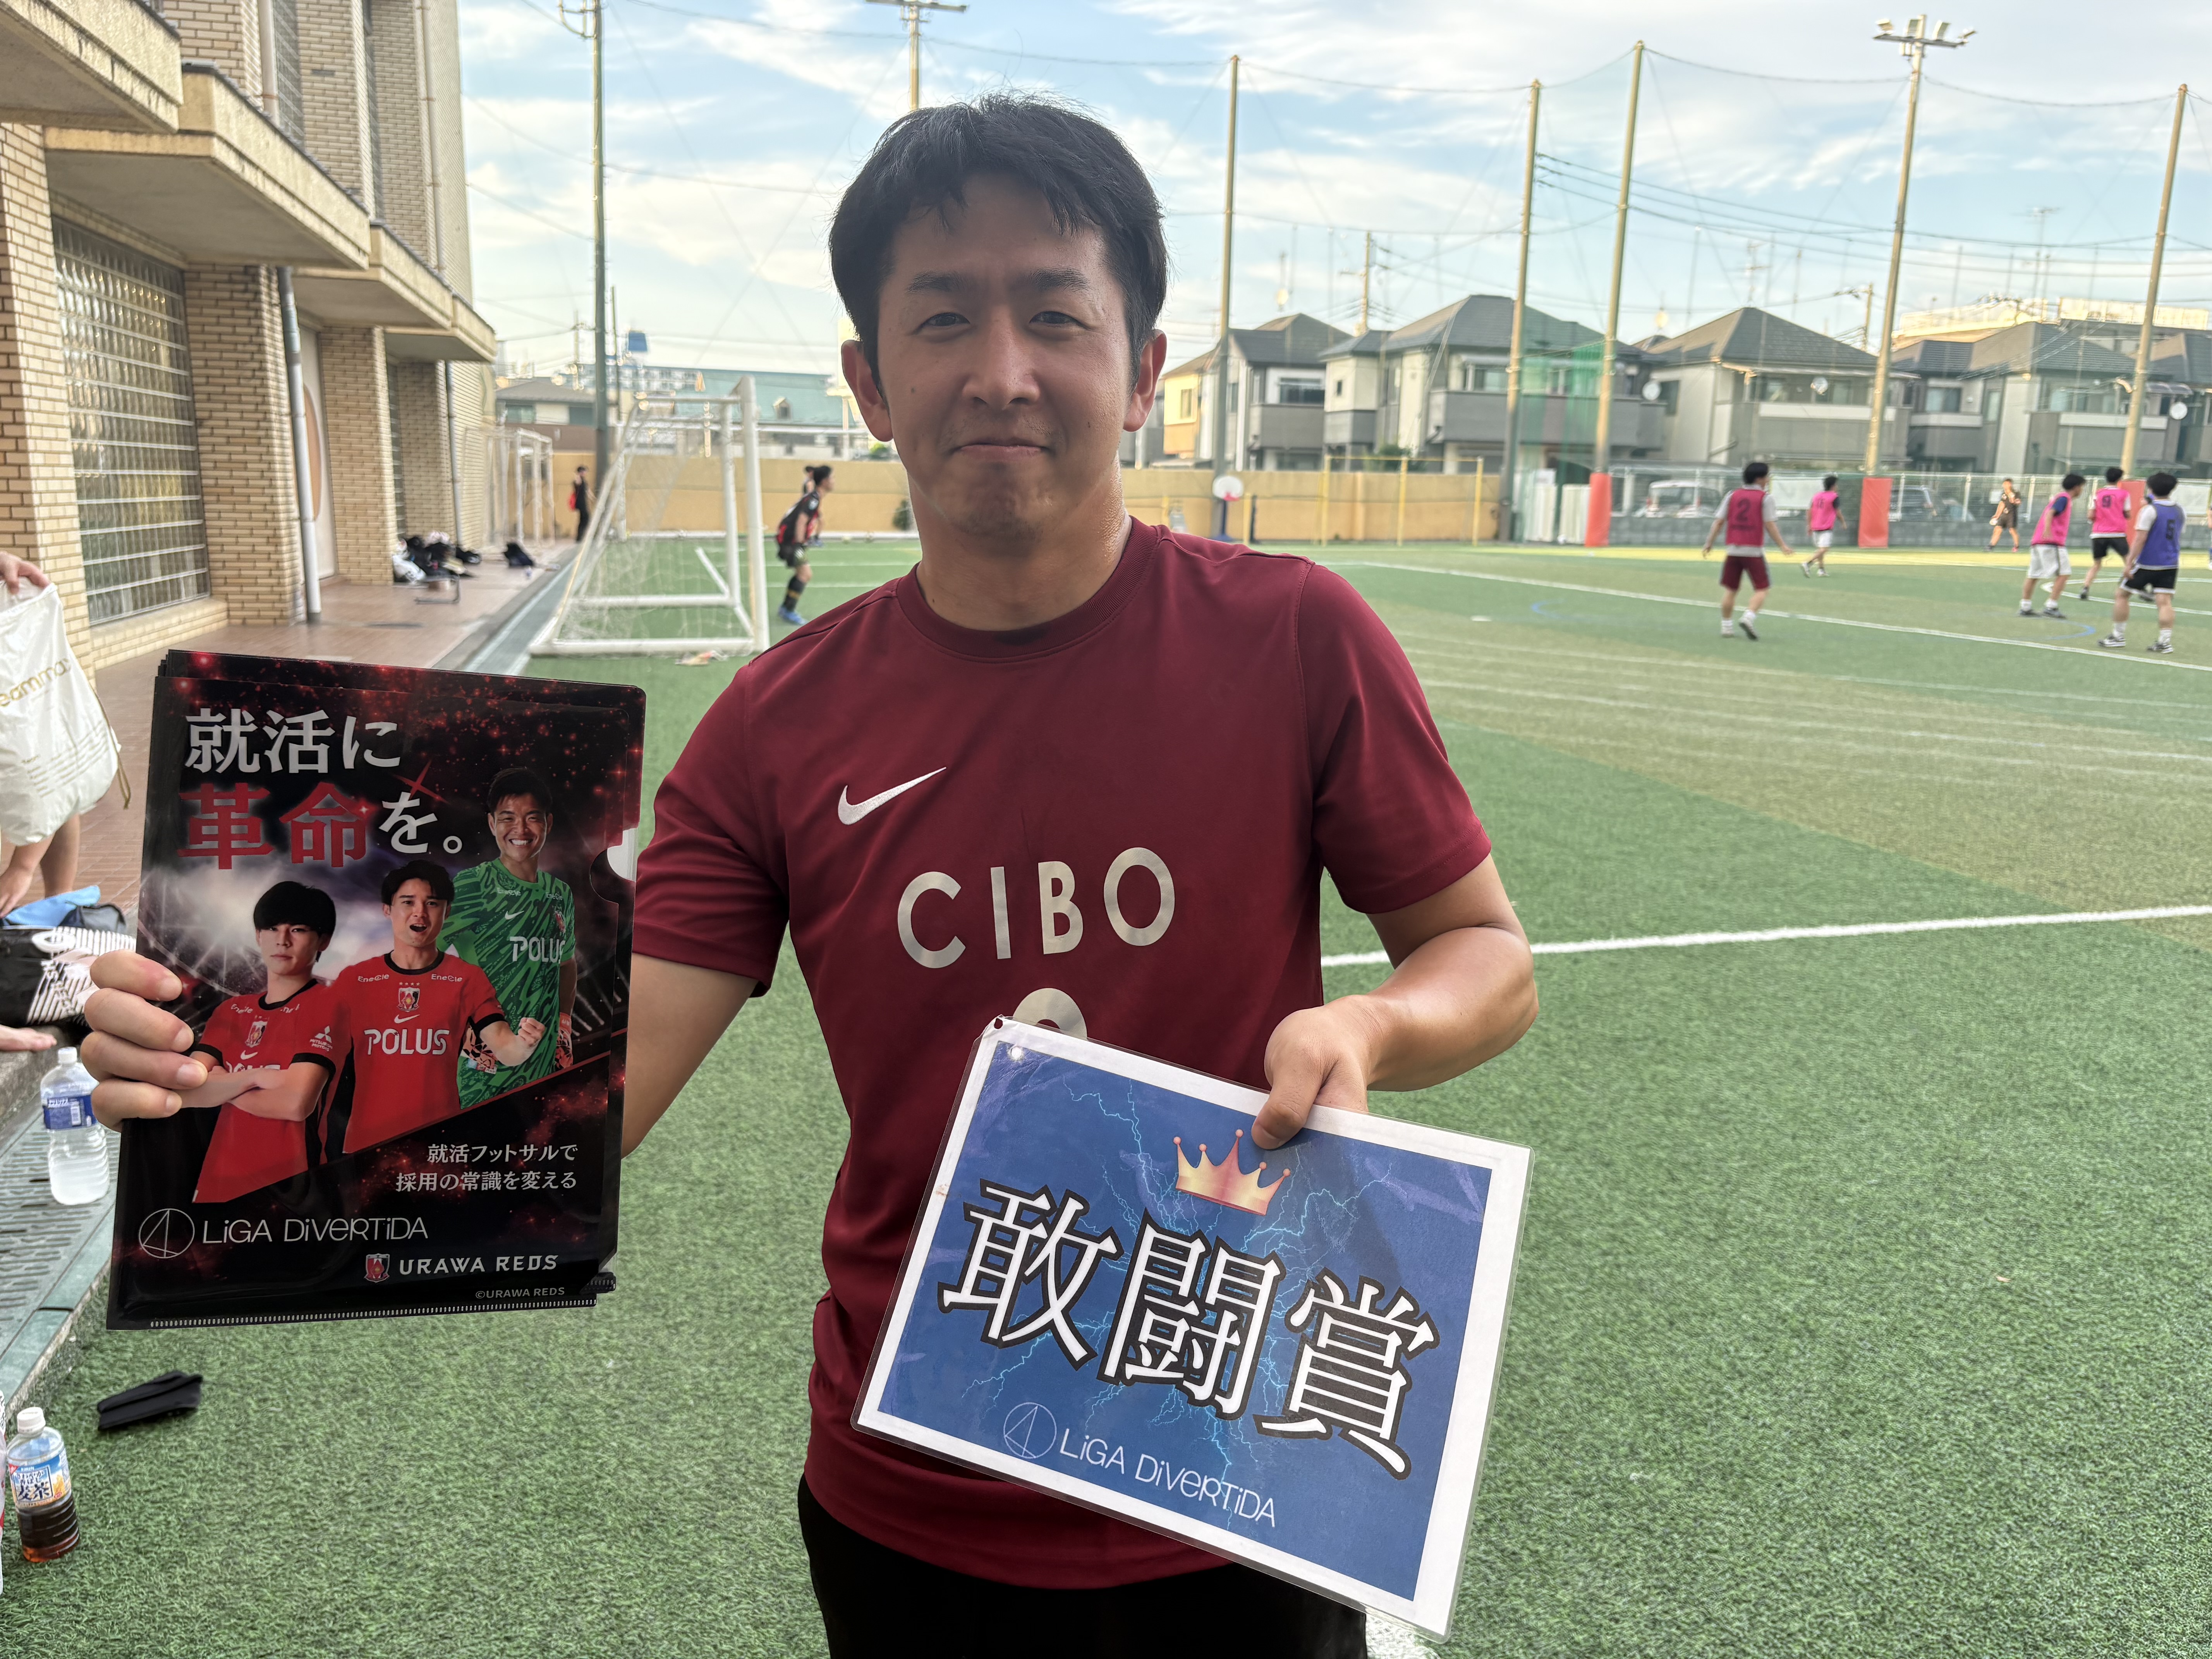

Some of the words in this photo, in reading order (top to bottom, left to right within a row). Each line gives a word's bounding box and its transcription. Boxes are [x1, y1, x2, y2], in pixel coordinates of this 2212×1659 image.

[1736, 498, 1751, 522] 2
[185, 708, 400, 773] 就活に
[177, 781, 462, 870] 革命を。
[898, 847, 1175, 969] CIBO
[358, 974, 390, 982] EneCle
[431, 974, 462, 982] EneCle
[364, 1029, 450, 1055] POLUS
[427, 1143, 579, 1163] 就活フットサルで
[395, 1171, 577, 1192] 採用の常識を変える
[203, 1219, 272, 1244] LiGA
[399, 1257, 485, 1275] URAWA
[496, 1255, 559, 1271] REDS
[533, 1287, 565, 1296] REDS
[938, 1178, 1441, 1480] 敢闘賞
[1060, 1428, 1125, 1474] LiGA
